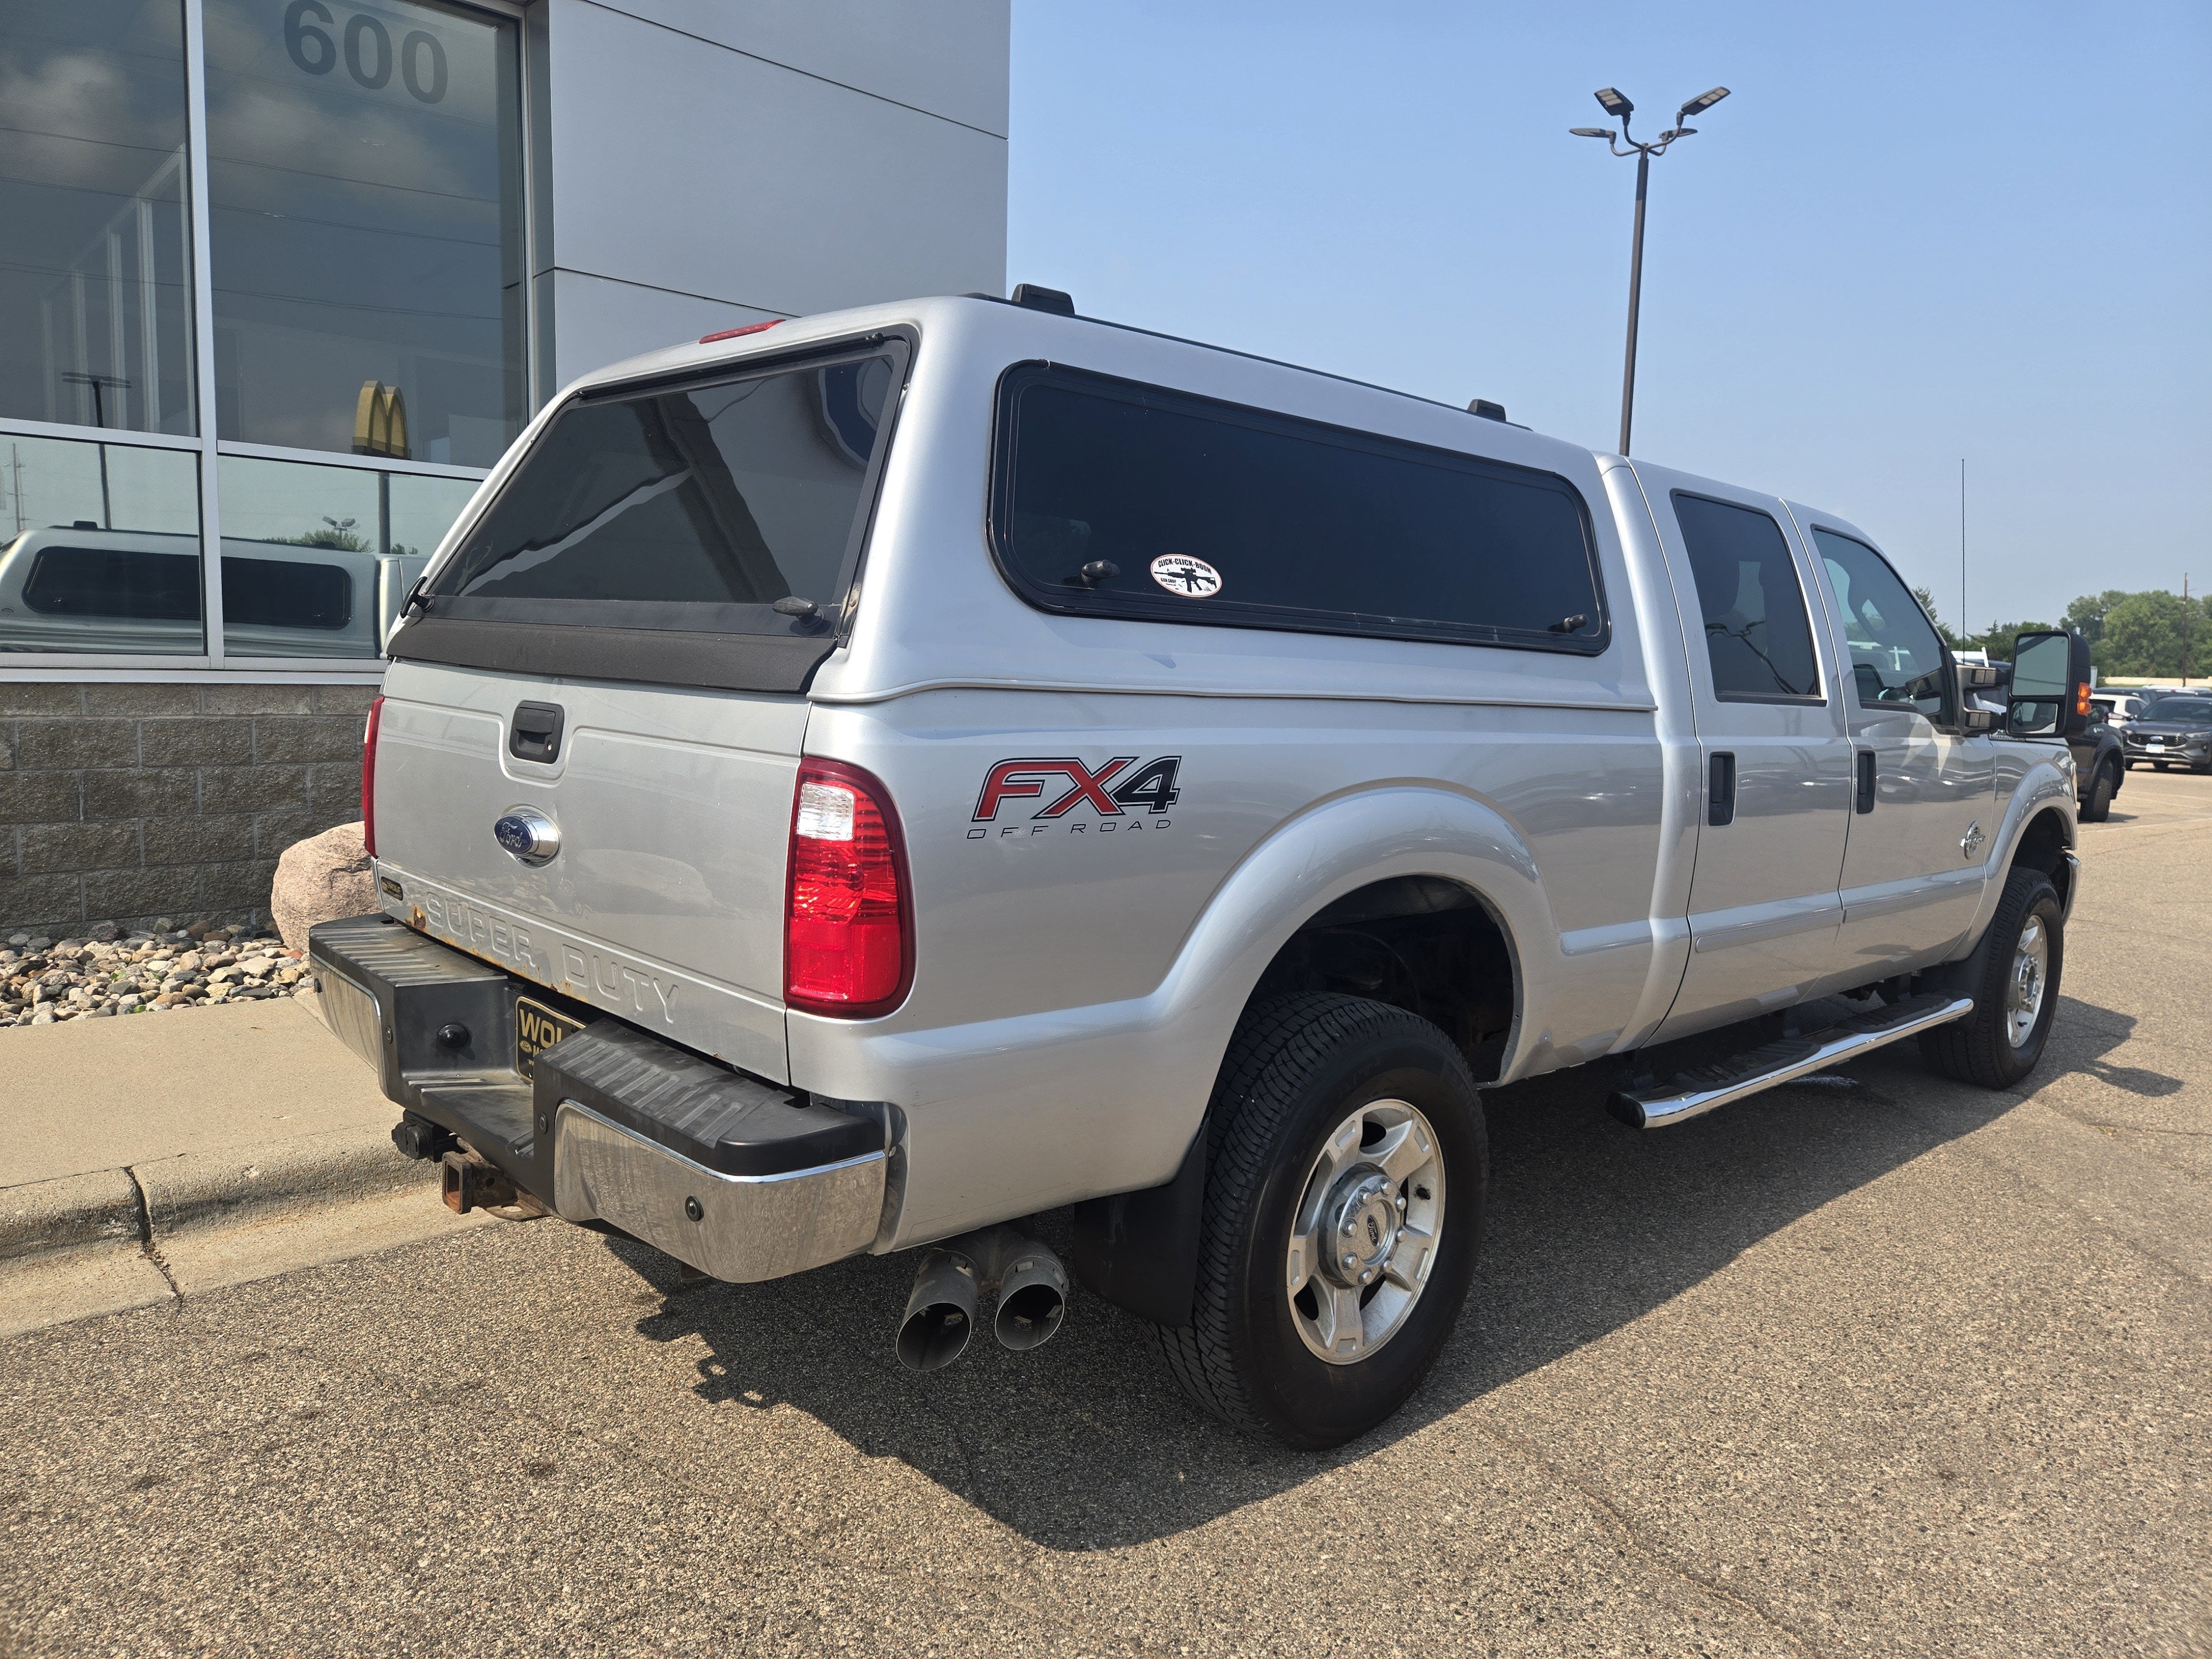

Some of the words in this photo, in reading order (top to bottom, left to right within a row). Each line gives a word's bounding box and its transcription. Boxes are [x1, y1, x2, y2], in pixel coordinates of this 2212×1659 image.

[284, 0, 448, 104] 600
[1158, 558, 1212, 575] CLICK-CLICK-BOOM
[971, 755, 1182, 822] FX4
[498, 821, 523, 848] Ford
[966, 825, 1049, 839] OFF
[1070, 819, 1172, 834] ROAD
[425, 891, 536, 968] SUPER
[561, 943, 680, 1024] DUTY
[1368, 1222, 1377, 1241] Ford
